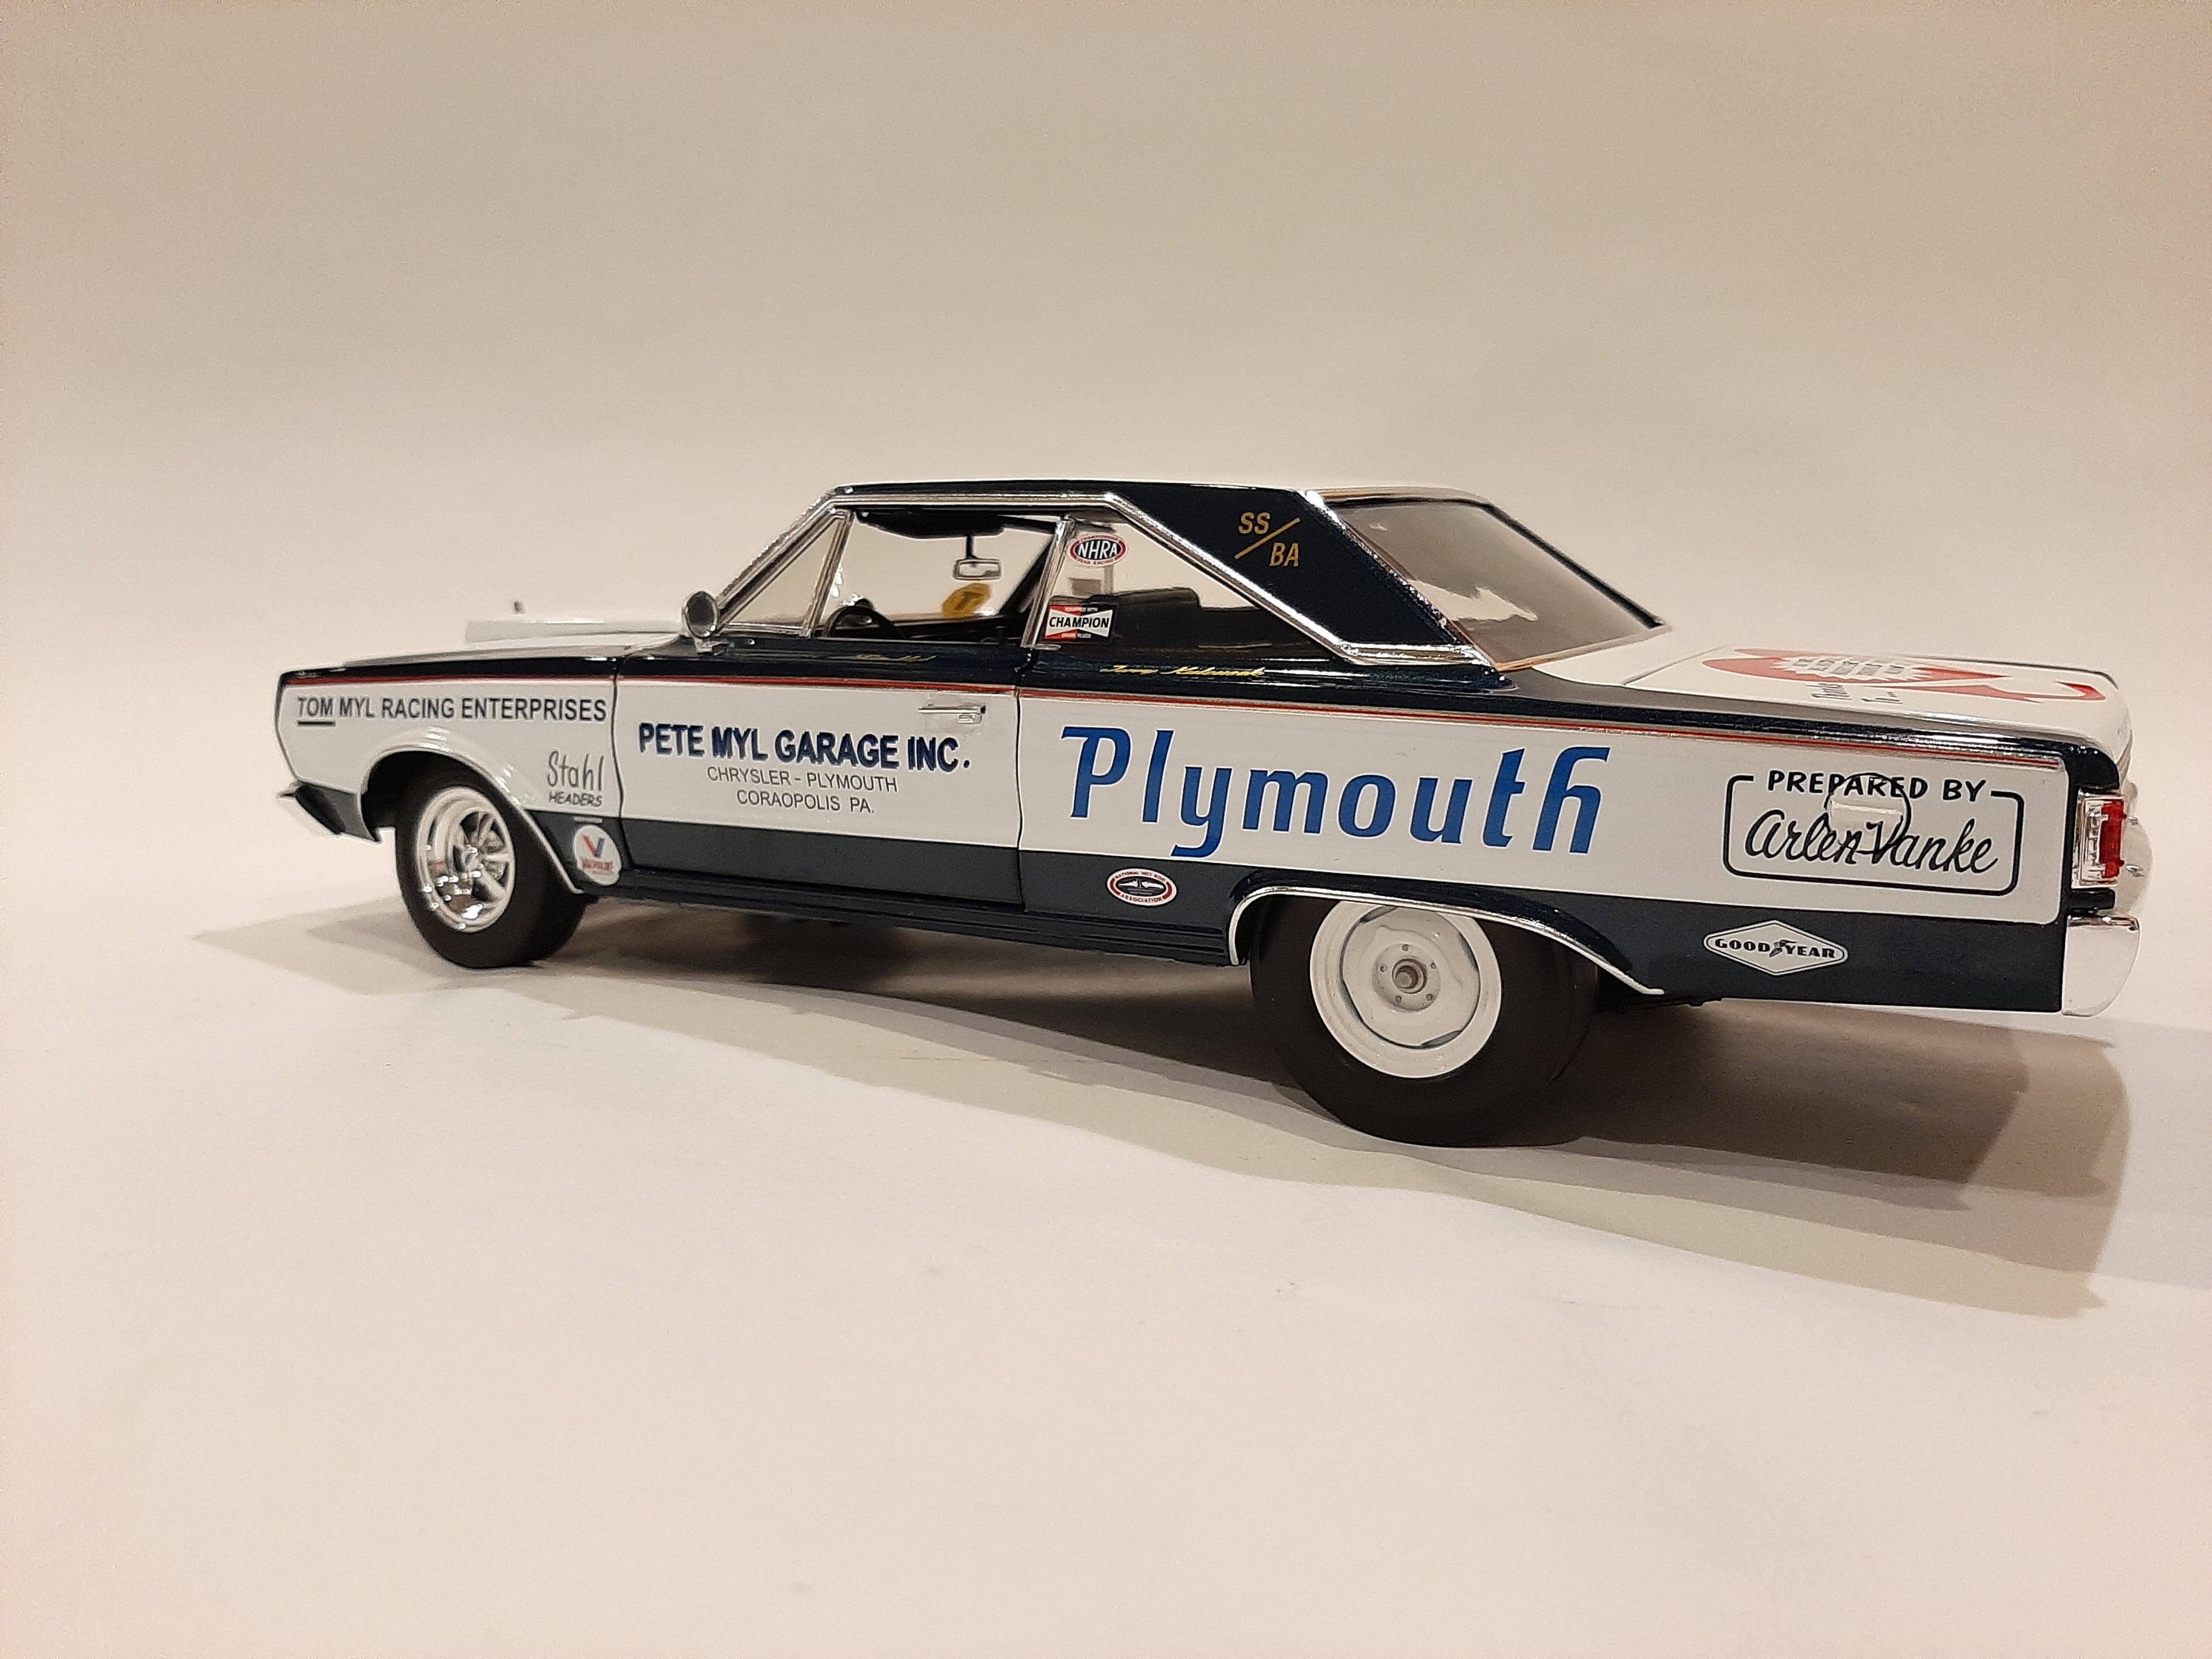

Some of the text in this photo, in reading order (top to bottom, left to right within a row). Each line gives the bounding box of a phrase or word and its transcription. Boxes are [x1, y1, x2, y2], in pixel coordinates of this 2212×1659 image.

[1238, 512, 1271, 535] SS
[1078, 540, 1118, 559] NHRA
[1269, 543, 1299, 567] BA
[1049, 616, 1109, 628] CHAMPION
[297, 697, 607, 721] TOM MYL RACING ENTERPRISES
[638, 722, 971, 772] PETE MYL GARAGE INC.
[547, 750, 604, 791] Stahl
[707, 766, 791, 786] CHRYSLER
[806, 772, 898, 793] PLYMOUTH
[1060, 726, 1611, 858] Plymouth
[1768, 770, 1987, 802] PREPARED BY
[549, 791, 602, 806] HEADERS
[737, 789, 875, 814] CORAOPOLIS PA.
[1120, 893, 1163, 903] ASSOCIATION
